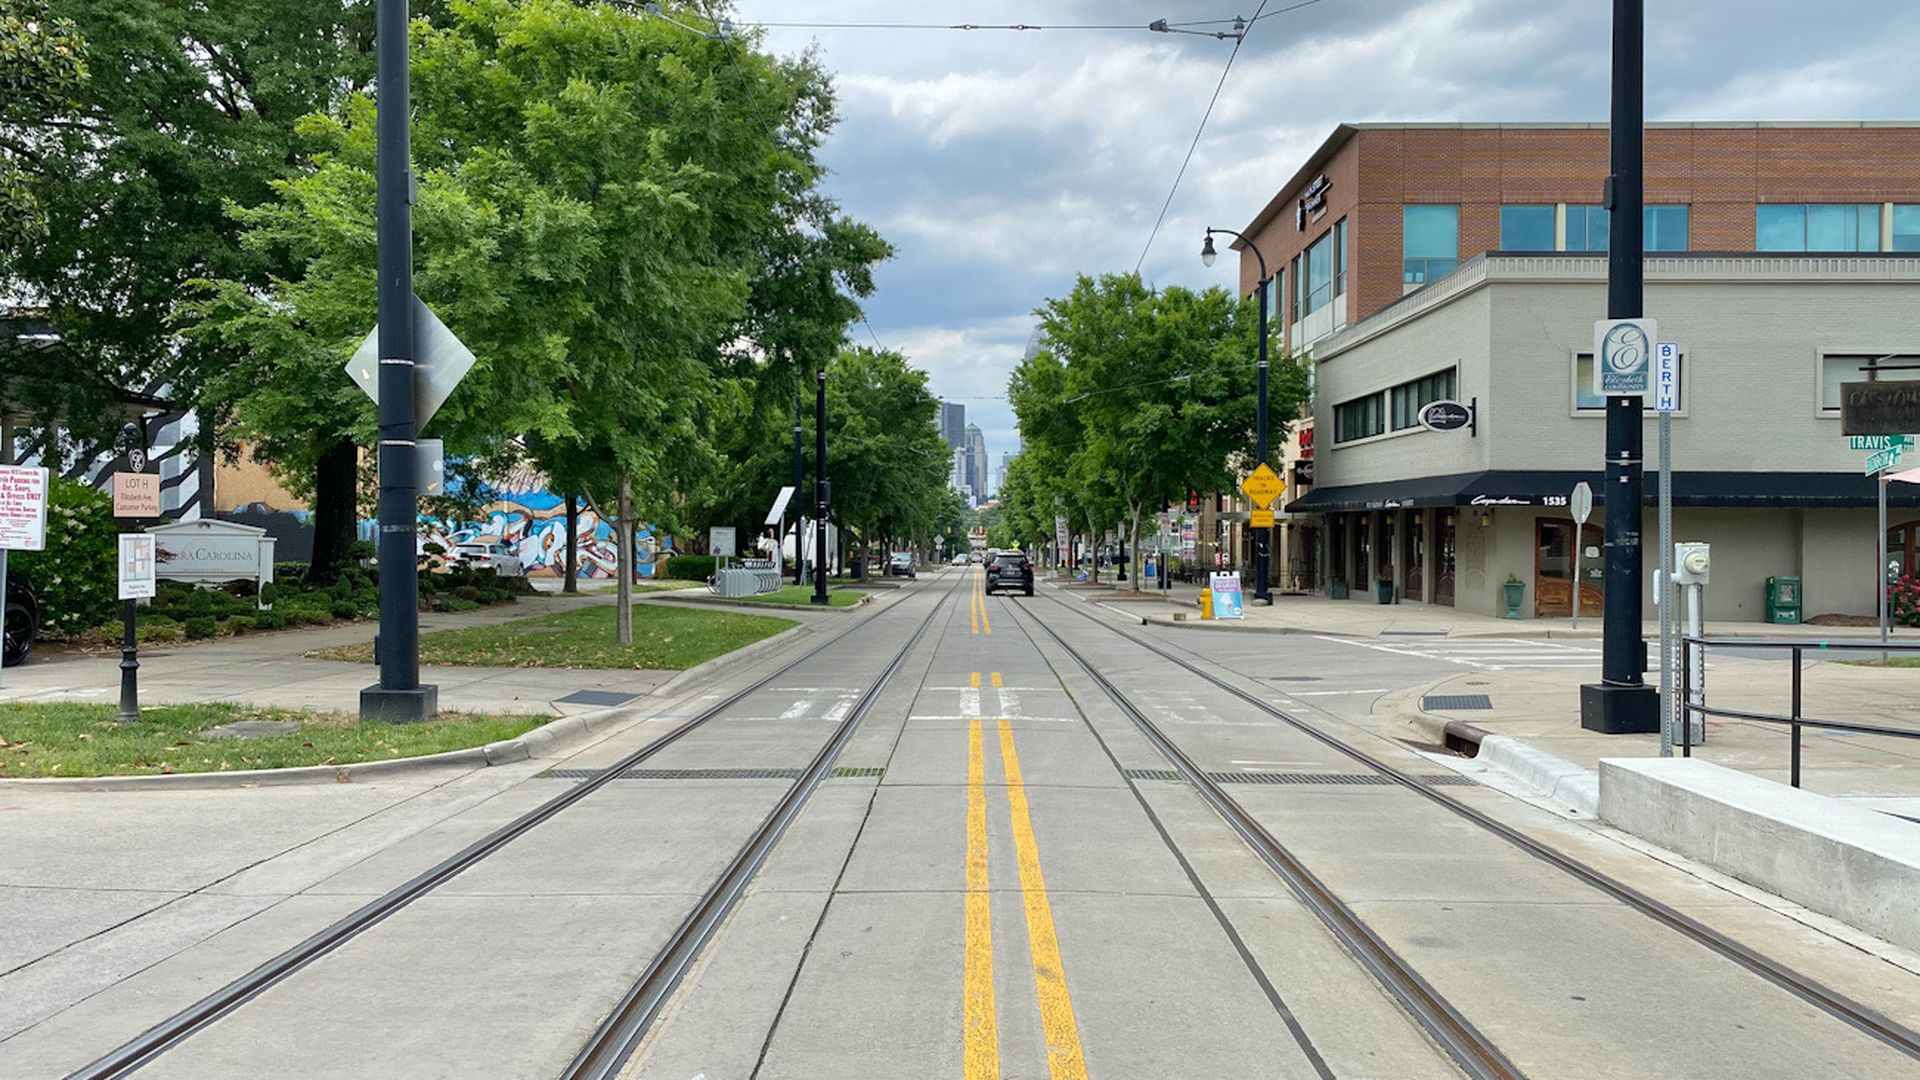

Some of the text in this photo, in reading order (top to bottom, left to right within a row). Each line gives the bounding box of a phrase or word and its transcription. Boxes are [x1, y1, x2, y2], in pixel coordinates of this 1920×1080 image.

[1661, 345, 1672, 407] BERTH
[1851, 435, 1891, 449] TRAVIS
[125, 478, 149, 489] LOT H
[1543, 496, 1567, 506] 1535
[141, 504, 158, 513] Parking
[195, 547, 254, 561] CAROLINA
